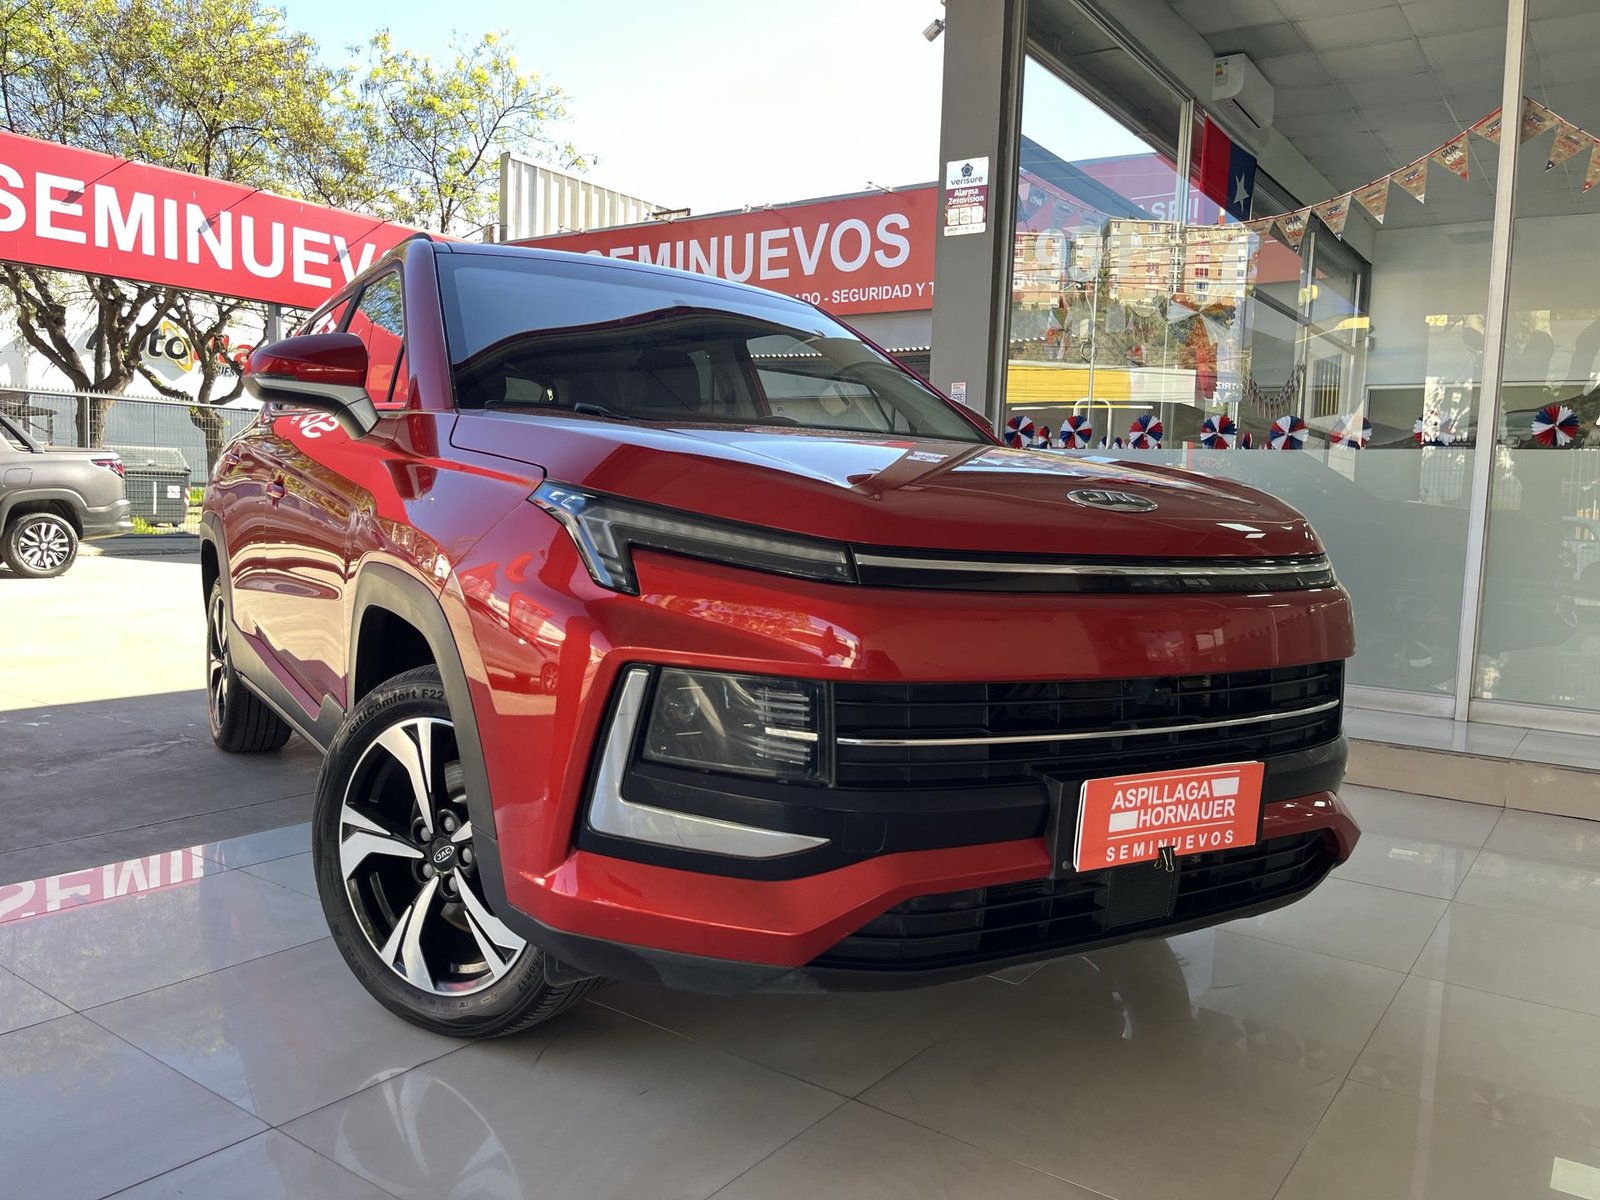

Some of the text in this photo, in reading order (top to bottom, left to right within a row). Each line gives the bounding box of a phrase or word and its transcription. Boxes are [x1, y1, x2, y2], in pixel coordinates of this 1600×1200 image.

[950, 176, 984, 186] verisure
[954, 188, 979, 197] Alarma
[0, 164, 391, 288] SEMINUEV
[832, 284, 912, 304] SEGURIDAD
[916, 283, 926, 297] Y
[1111, 781, 1211, 810] ASPILLAGA
[1139, 799, 1236, 828] HORNAUER
[1106, 829, 1234, 862] SEMINUEVOS
